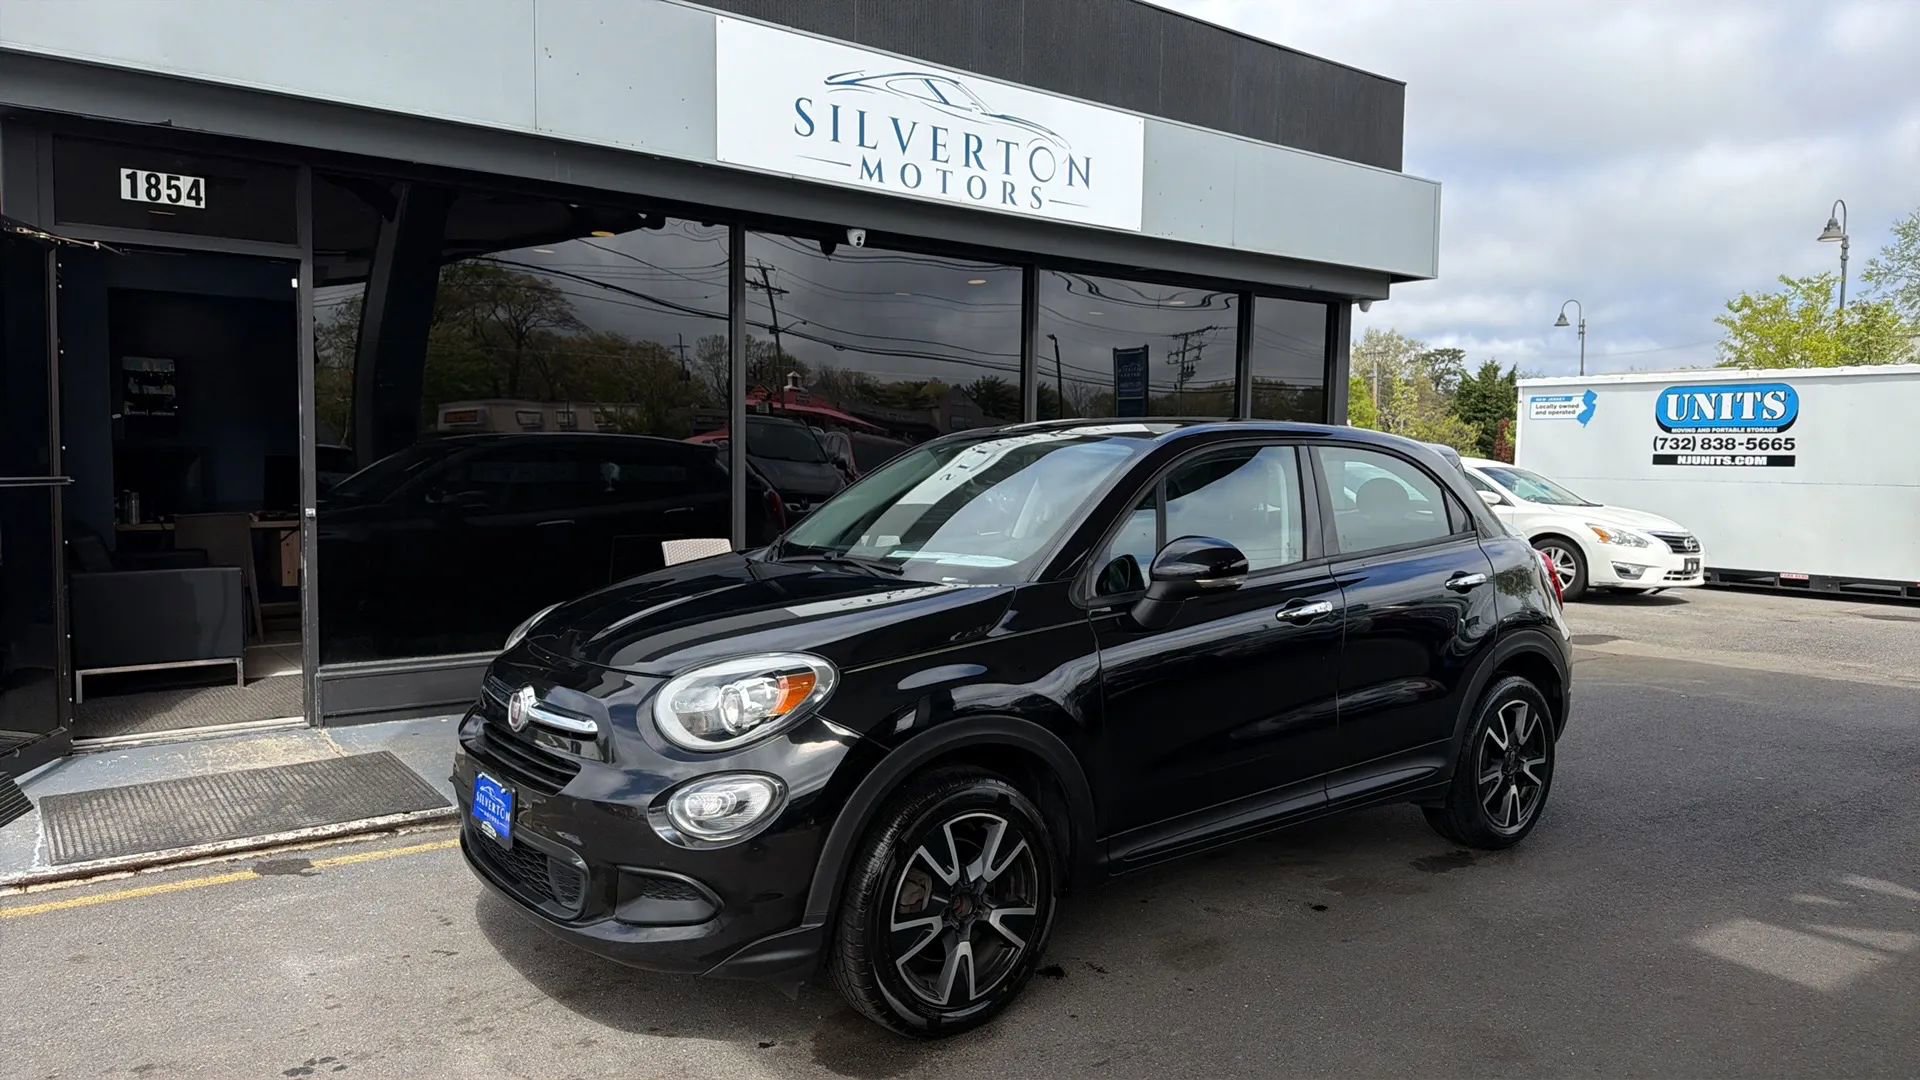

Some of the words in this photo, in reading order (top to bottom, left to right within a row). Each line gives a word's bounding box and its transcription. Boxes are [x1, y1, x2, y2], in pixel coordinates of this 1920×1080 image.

[793, 96, 1092, 190] SILVERTON
[125, 170, 203, 207] 1854
[859, 155, 1043, 210] MOTORS
[1666, 391, 1786, 421] UNITS
[1653, 436, 1696, 452] (732)
[1700, 437, 1796, 451] 838-5665
[1677, 455, 1768, 466] NJUNITS.COM
[476, 791, 510, 822] SILVERTON
